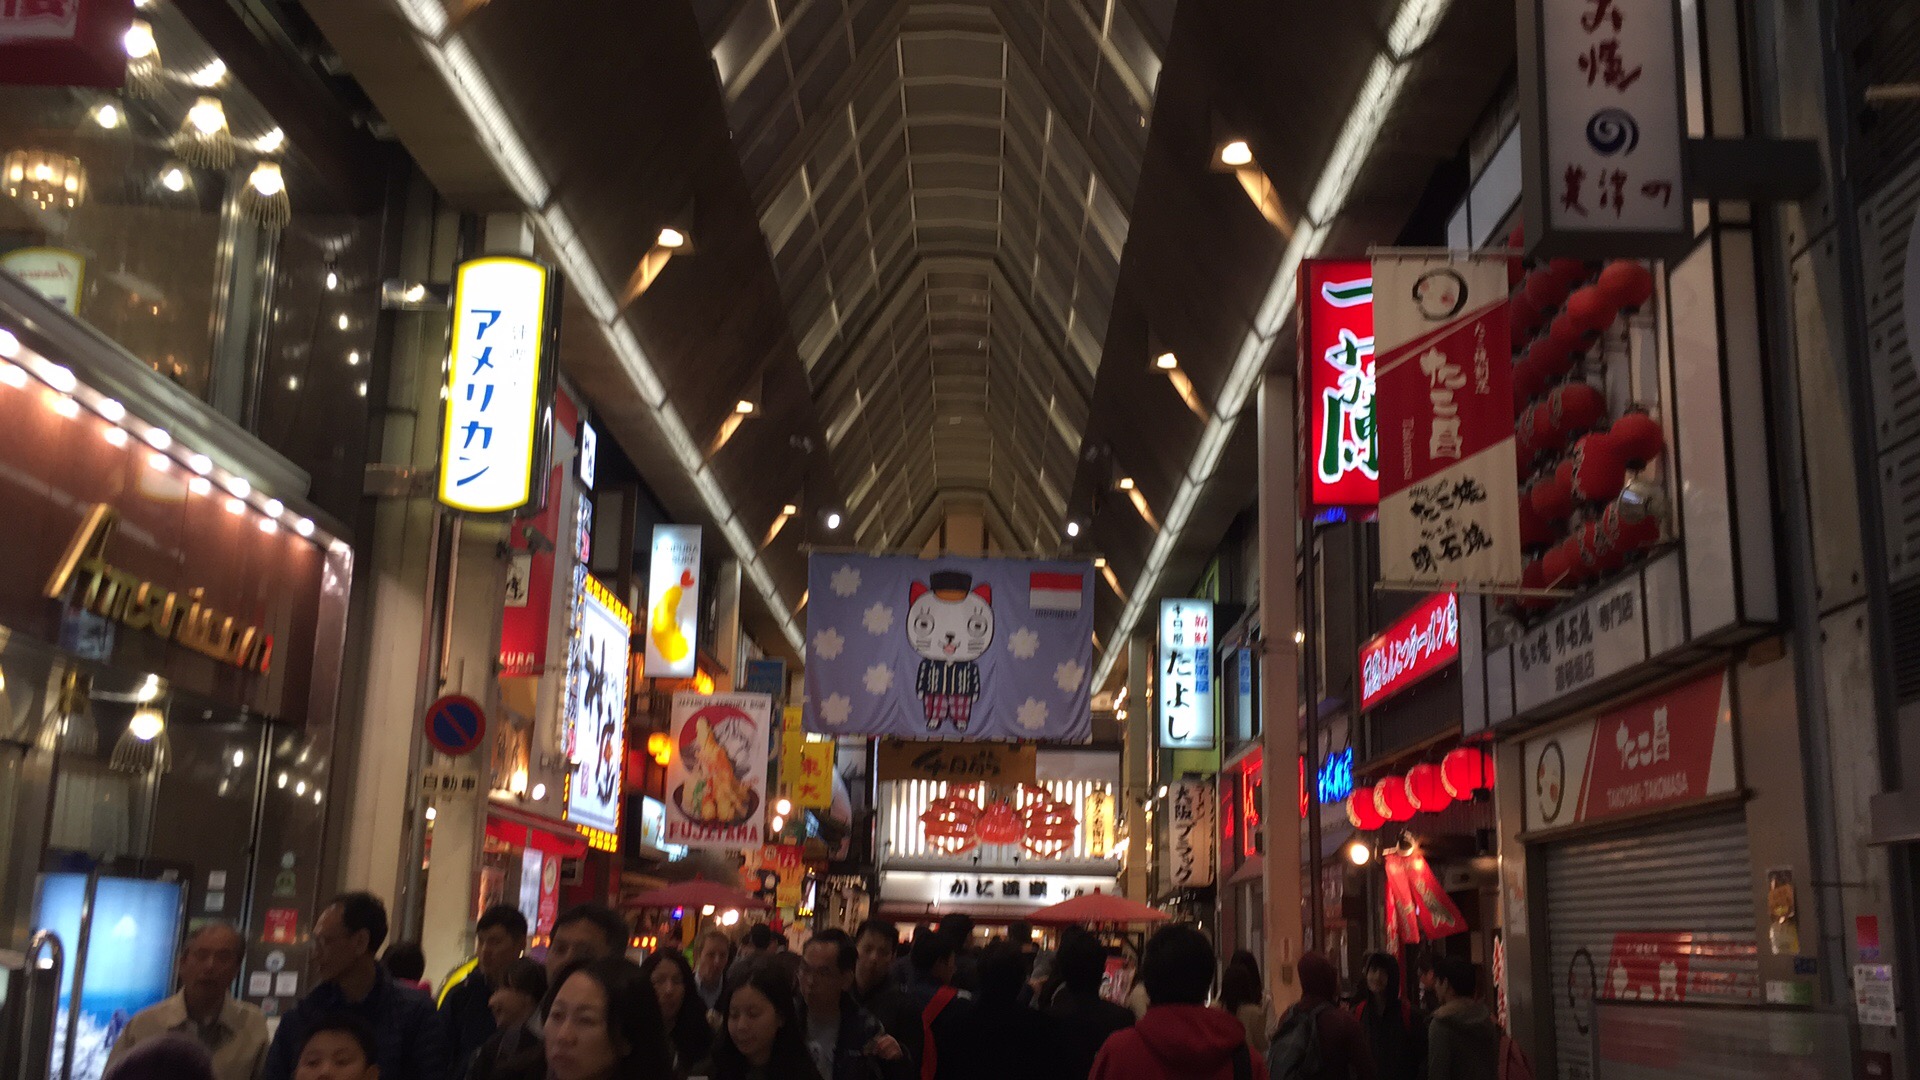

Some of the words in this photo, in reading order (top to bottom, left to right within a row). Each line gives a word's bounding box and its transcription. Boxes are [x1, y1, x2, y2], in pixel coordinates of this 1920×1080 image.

[457, 309, 501, 487] アメリカン
[1166, 650, 1192, 741] たよし
[1615, 703, 1671, 771] たこ昌
[423, 774, 476, 792] 自動車
[669, 822, 758, 843] FUJIYAMA
